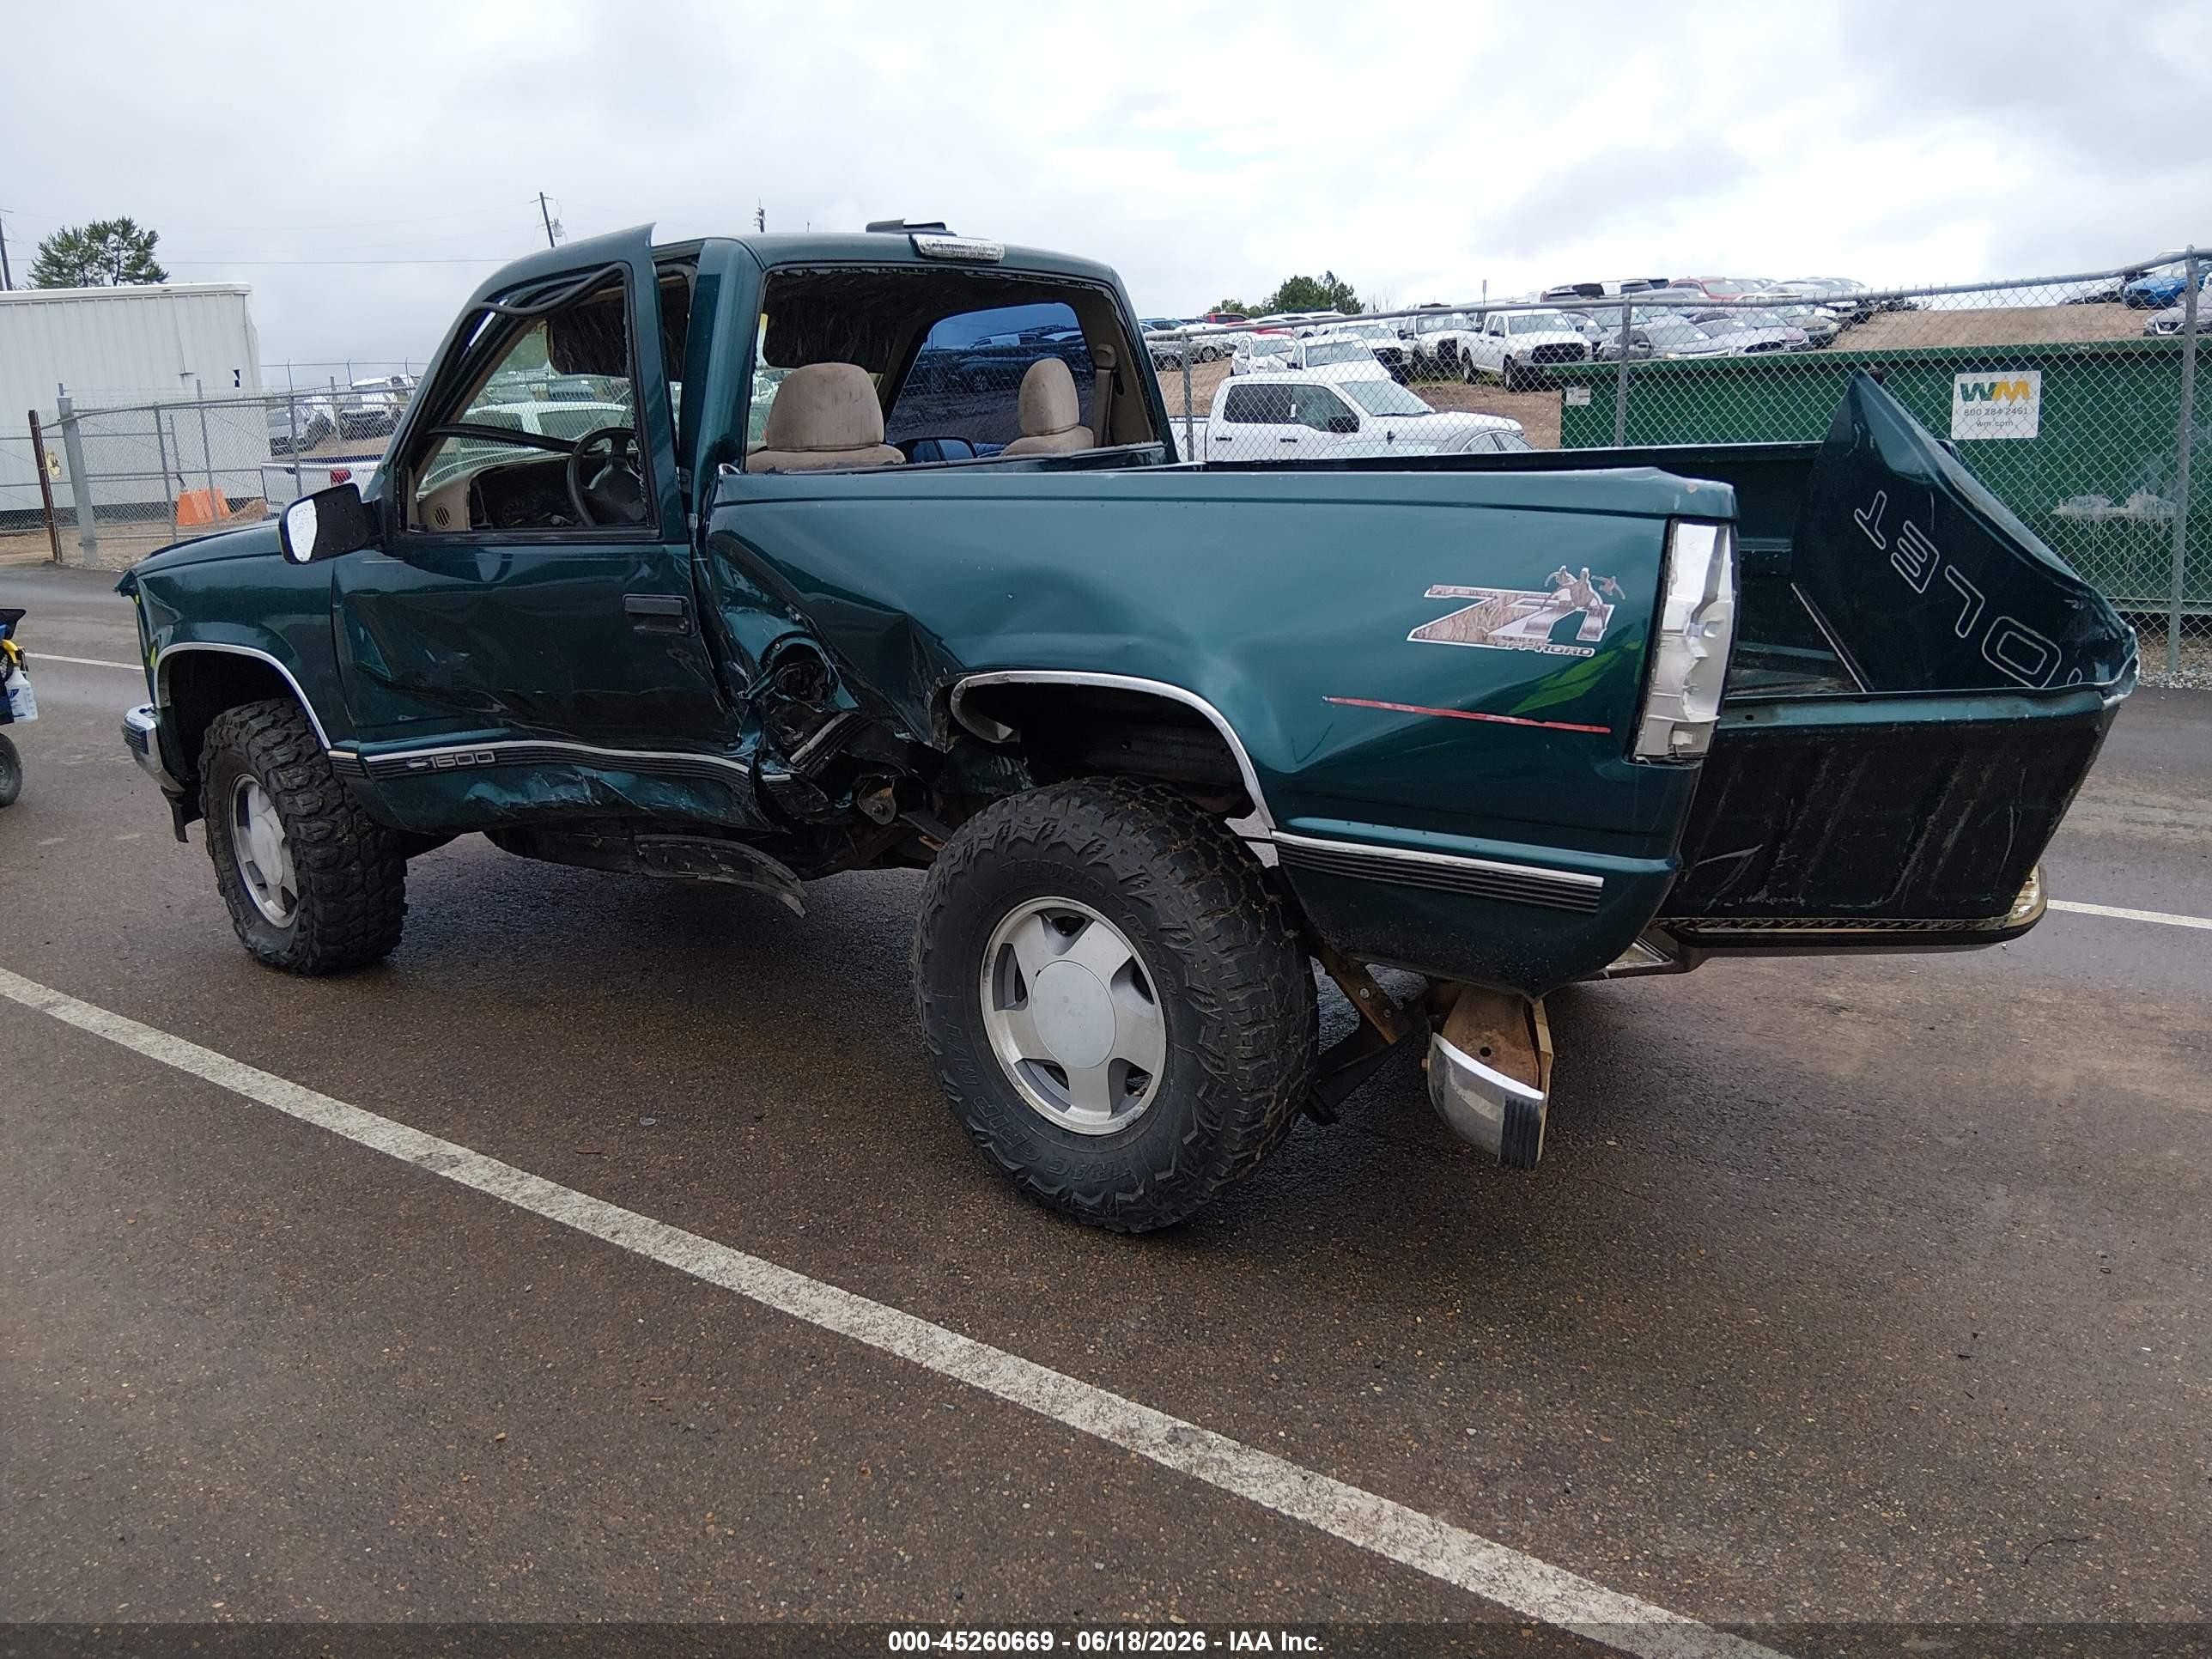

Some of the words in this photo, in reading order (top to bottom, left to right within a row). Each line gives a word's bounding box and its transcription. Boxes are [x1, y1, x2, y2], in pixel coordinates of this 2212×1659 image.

[1960, 380, 2031, 402] WM
[1964, 408, 1982, 416] 800
[429, 750, 495, 769] 1500
[972, 1095, 1041, 1161] GRIP
